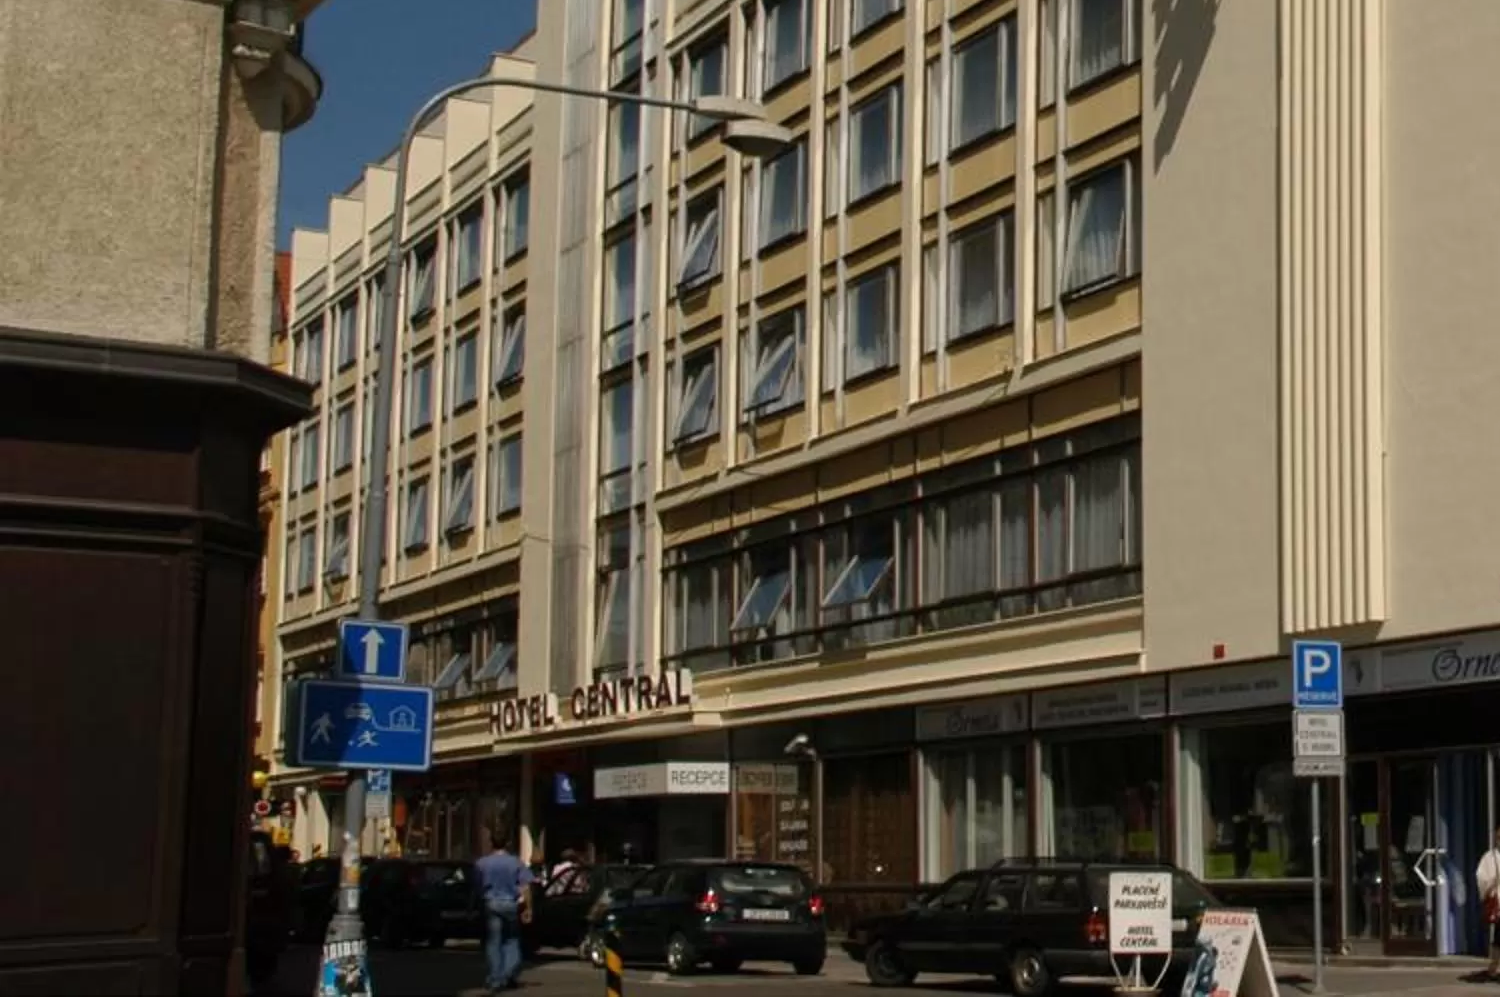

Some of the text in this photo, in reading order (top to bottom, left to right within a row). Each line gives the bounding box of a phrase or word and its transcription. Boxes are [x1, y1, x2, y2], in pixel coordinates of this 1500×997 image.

[1303, 649, 1331, 688] P
[489, 669, 691, 735] HOTEL CENTRAL
[671, 769, 727, 786] RECEPCE
